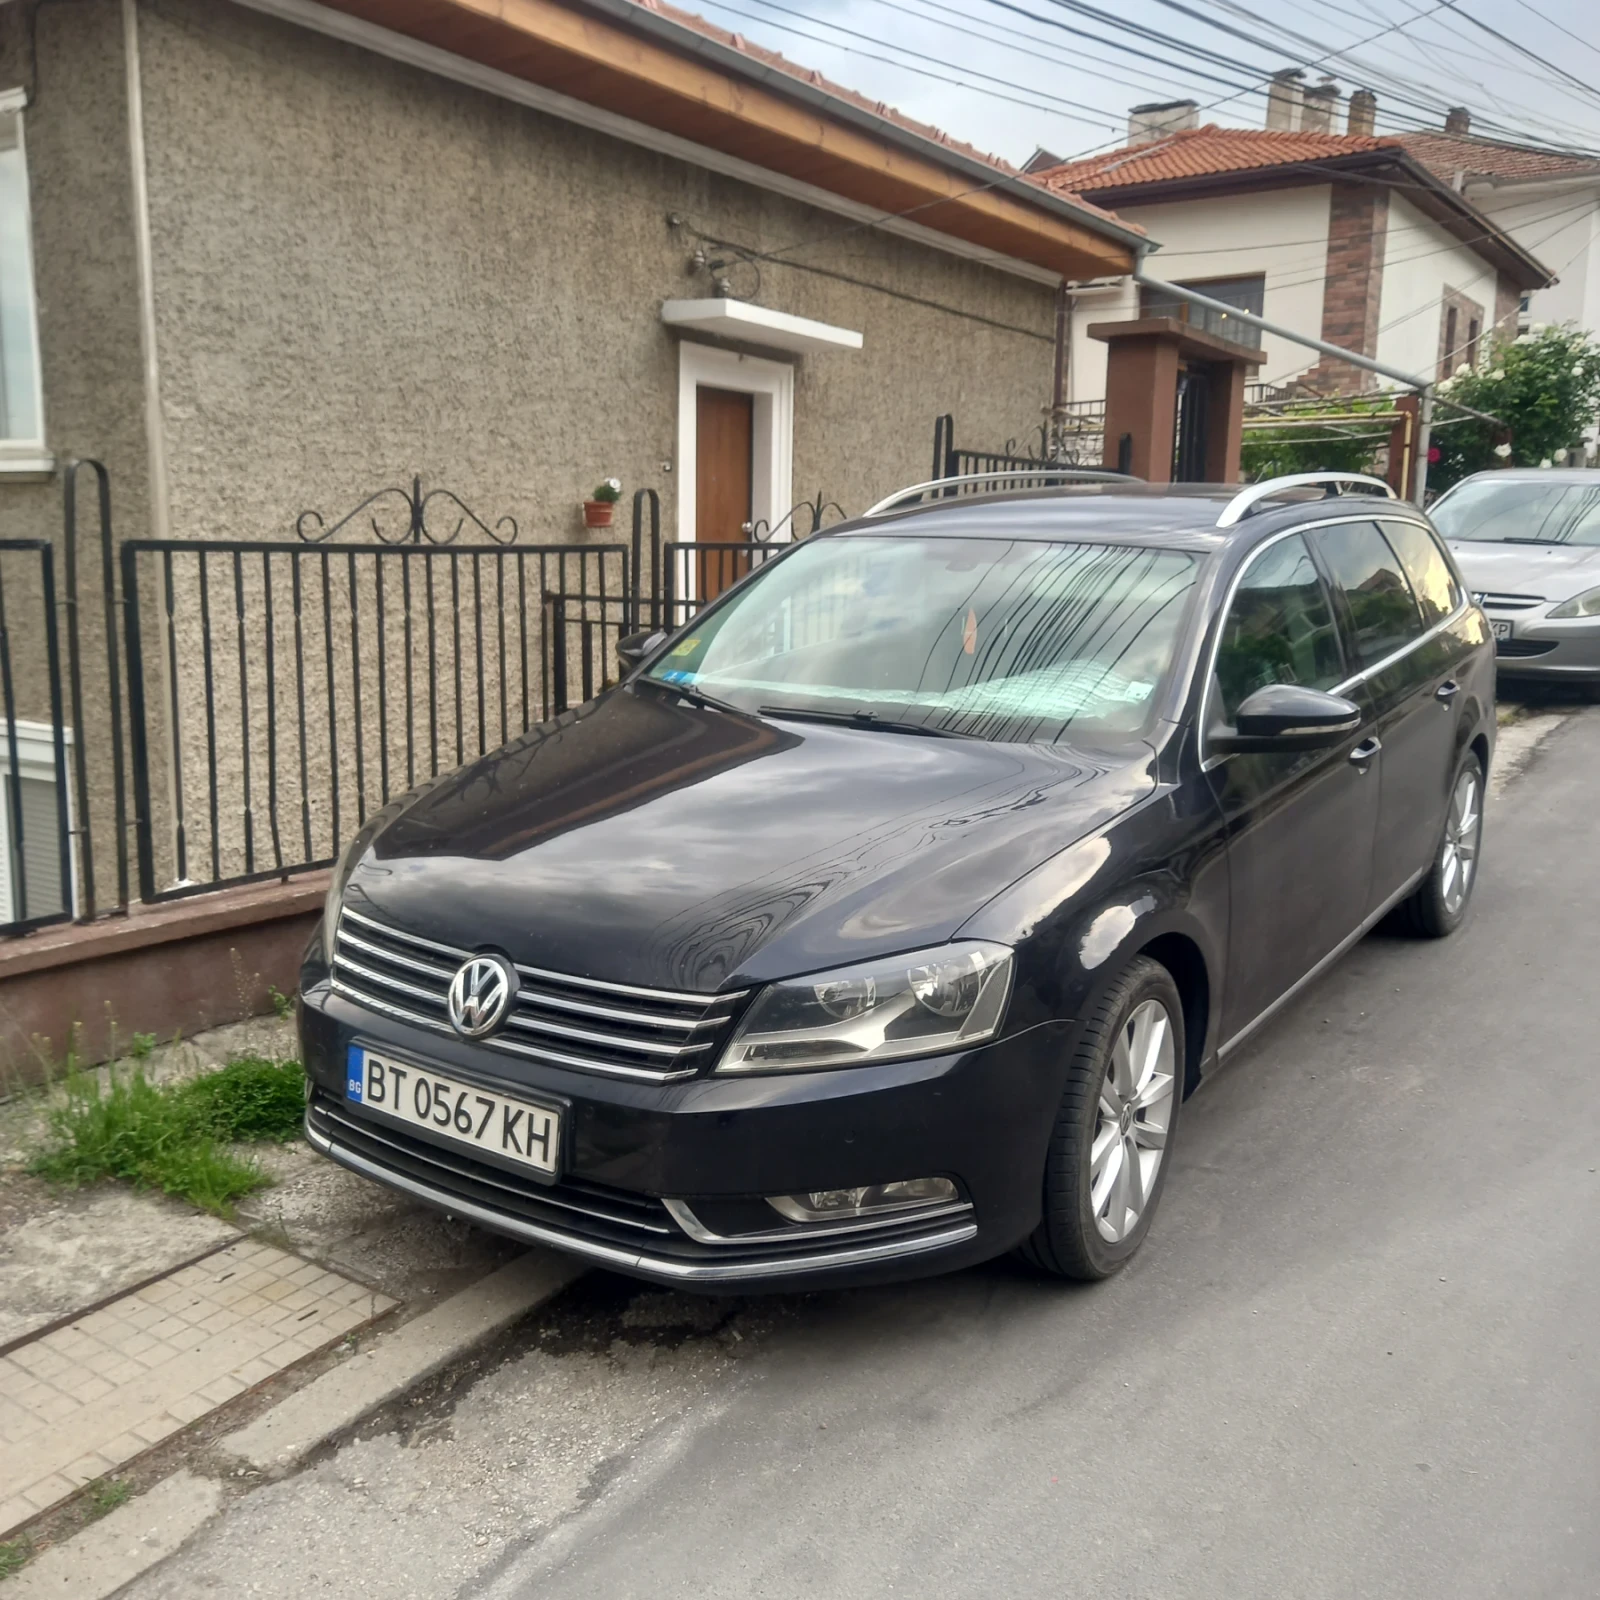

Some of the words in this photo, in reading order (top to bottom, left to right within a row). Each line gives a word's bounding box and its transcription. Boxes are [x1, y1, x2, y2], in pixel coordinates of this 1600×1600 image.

[349, 1079, 361, 1094] BG
[367, 1058, 407, 1110] BT
[414, 1077, 496, 1140] 0567
[502, 1104, 552, 1163] KH
